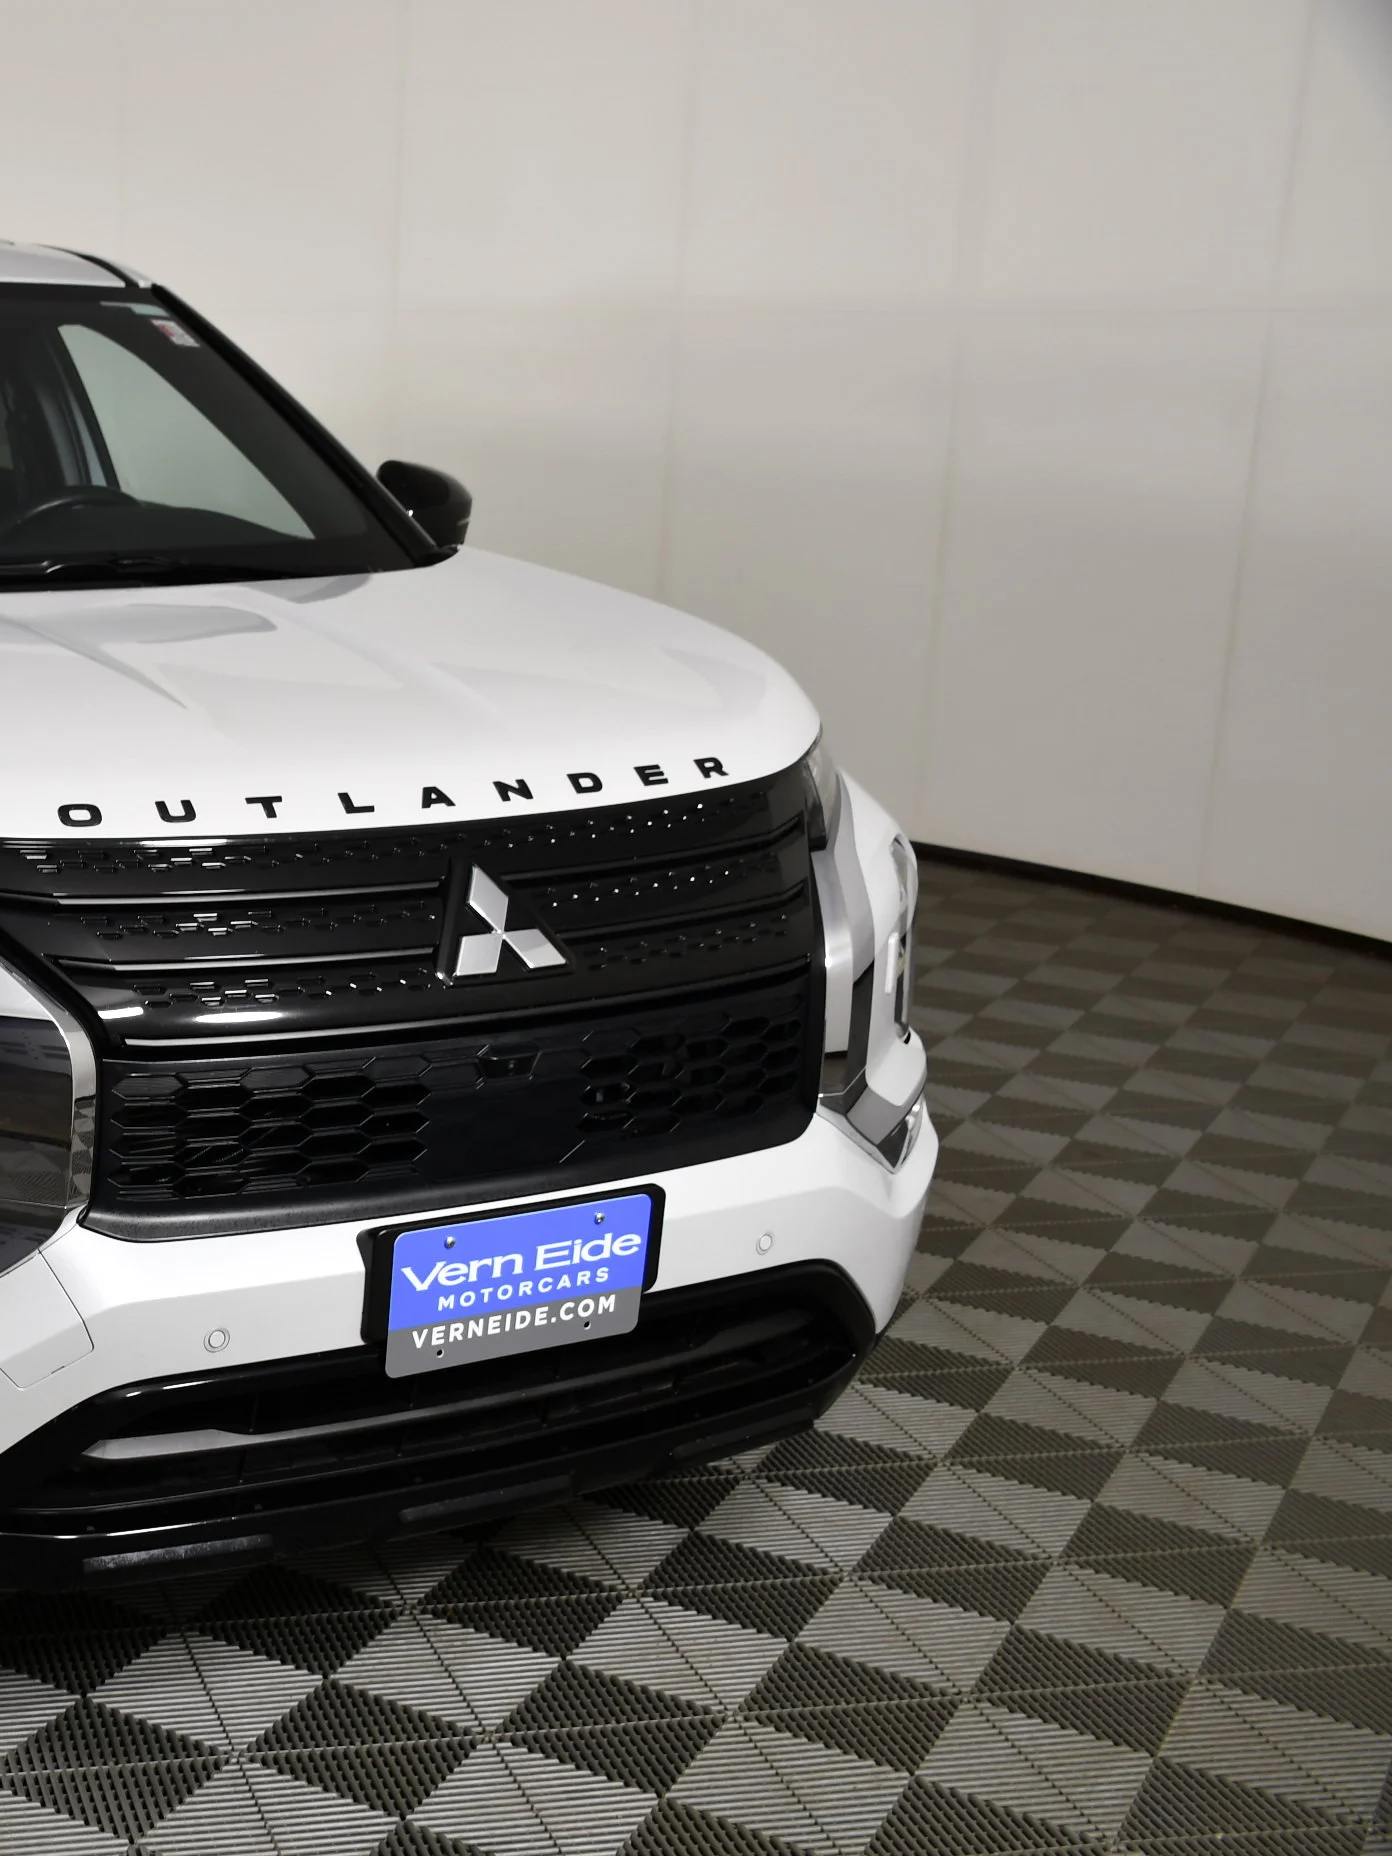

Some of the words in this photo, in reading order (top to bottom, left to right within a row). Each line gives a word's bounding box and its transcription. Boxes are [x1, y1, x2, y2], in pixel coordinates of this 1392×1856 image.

[57, 756, 729, 827] OUTLANDER
[401, 1253, 523, 1291] Vern
[534, 1232, 642, 1271] Eide
[437, 1266, 610, 1311] MOTORCARS
[411, 1294, 617, 1349] VERNEIDE.COM
